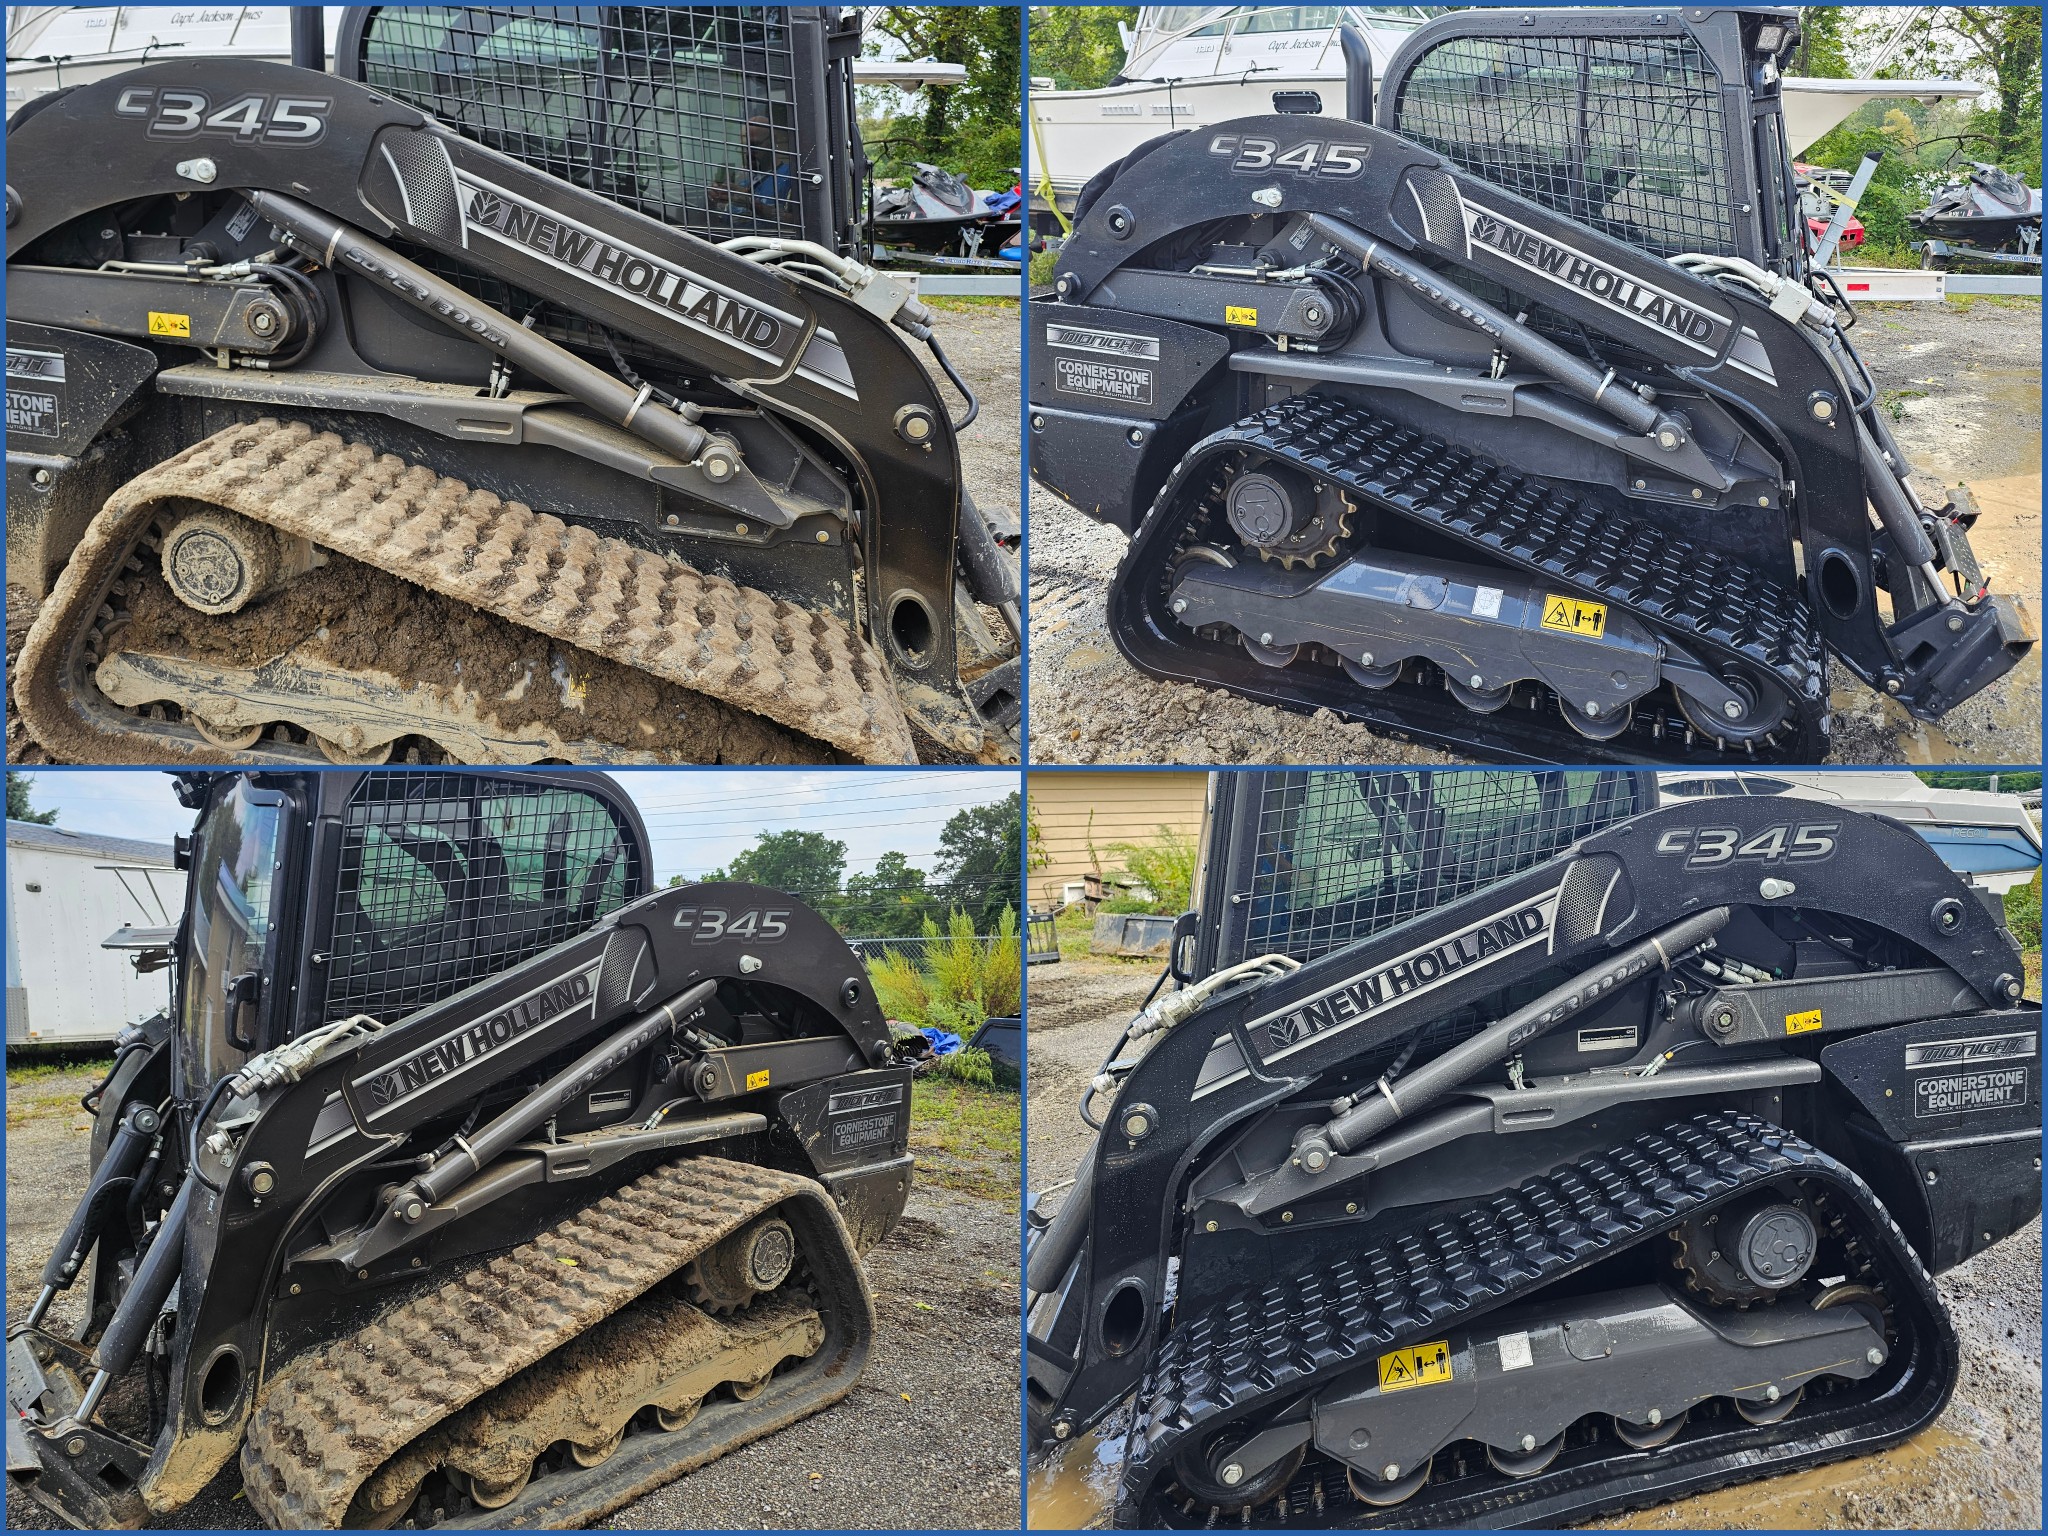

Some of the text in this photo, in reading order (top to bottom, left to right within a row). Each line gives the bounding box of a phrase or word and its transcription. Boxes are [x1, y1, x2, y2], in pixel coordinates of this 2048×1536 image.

[196, 10, 233, 23] Jackson
[117, 89, 328, 138] C345
[1209, 136, 1367, 174] C345
[501, 202, 781, 350] NEW HOLLAND
[1500, 225, 1714, 343] NEW HOLLAND
[345, 247, 511, 349] SUPER BOOM
[1377, 257, 1504, 339] SUPER BOOM
[1058, 360, 1149, 385] CORNERSTONE
[1066, 374, 1140, 396] EQUIPMENT
[1657, 824, 1839, 863] C345
[1953, 827, 1984, 838] REGAL
[673, 908, 791, 939] C345
[1300, 907, 1544, 1034] NEW HOLLAND
[1508, 954, 1649, 1047] SUPER BOOM
[399, 973, 590, 1093] NEW HOLLAND
[1918, 1070, 2024, 1095] CORNERSTONE
[1929, 1086, 2013, 1109] EQUIPMENT
[835, 1115, 894, 1135] CORNERSTONE
[840, 1127, 888, 1146] EQUIPMENT
